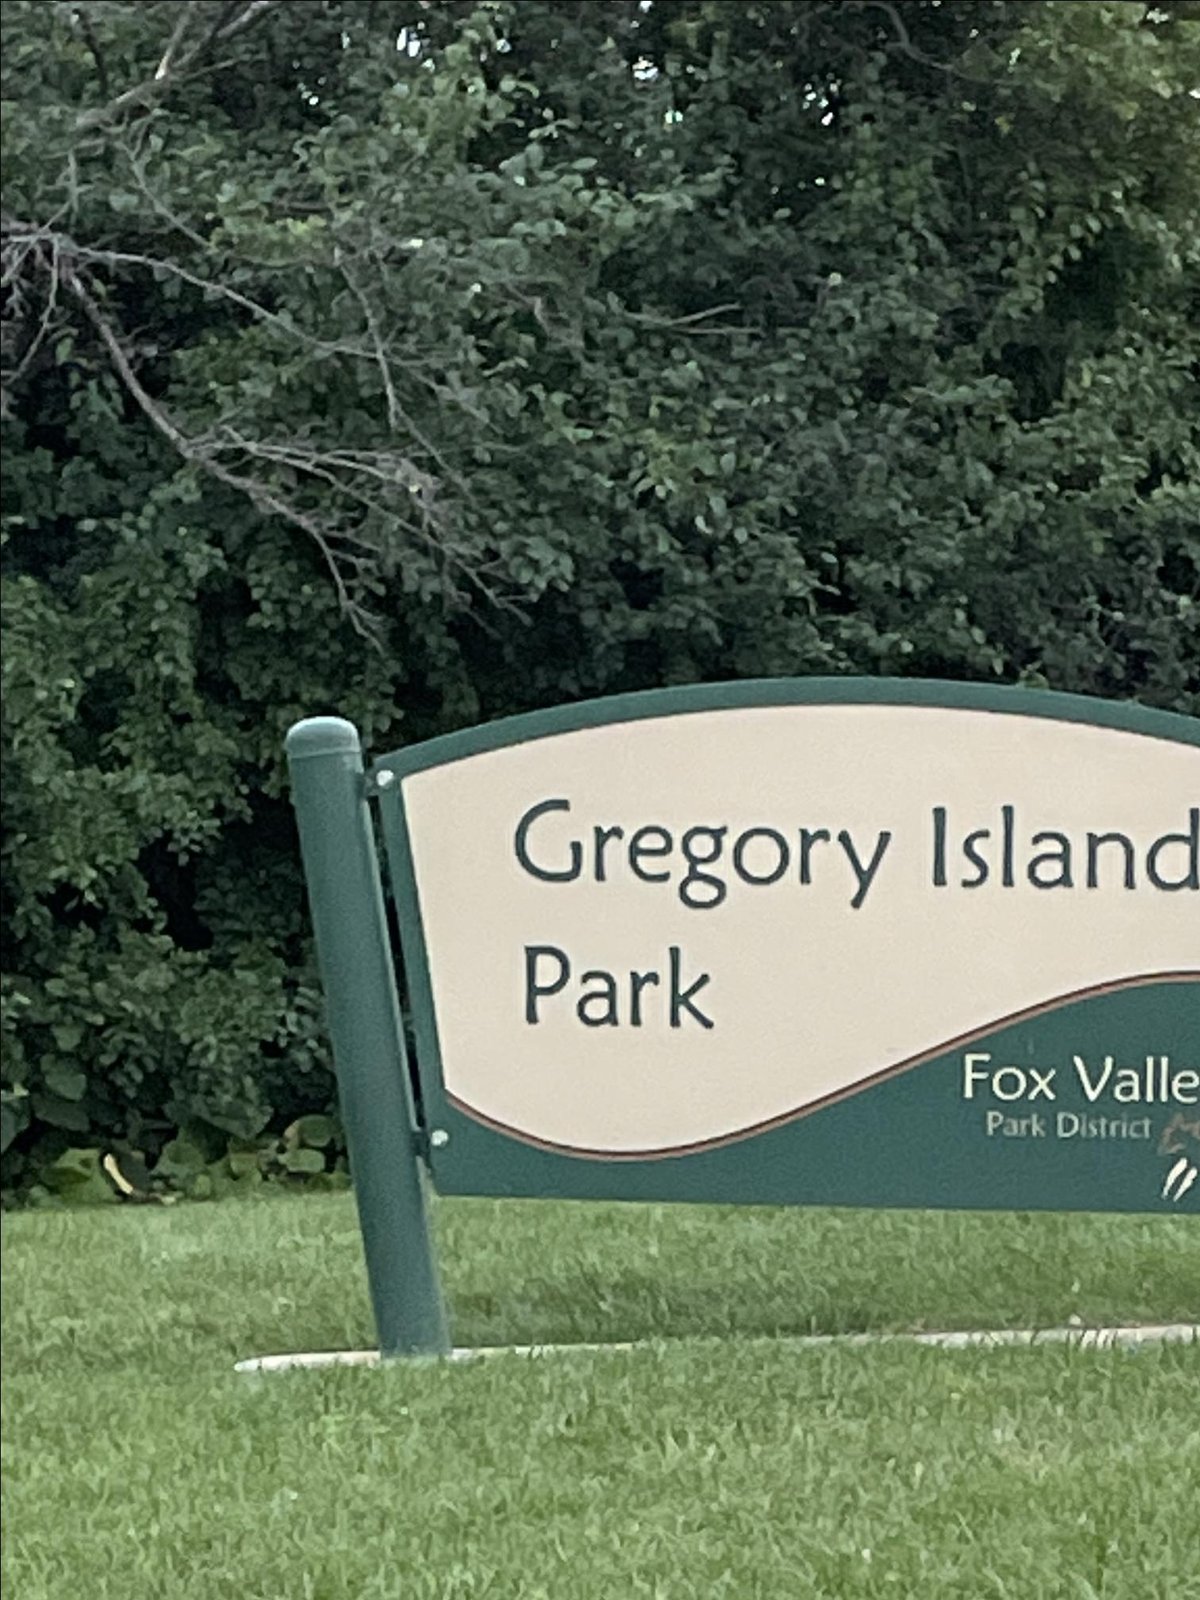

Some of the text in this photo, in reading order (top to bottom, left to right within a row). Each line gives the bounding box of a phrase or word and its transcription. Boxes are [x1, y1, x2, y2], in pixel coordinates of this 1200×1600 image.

[514, 798, 892, 909] Gregory
[523, 945, 715, 1030] Park
[963, 1053, 1057, 1101] Fox
[986, 1111, 1152, 1139] Park District
